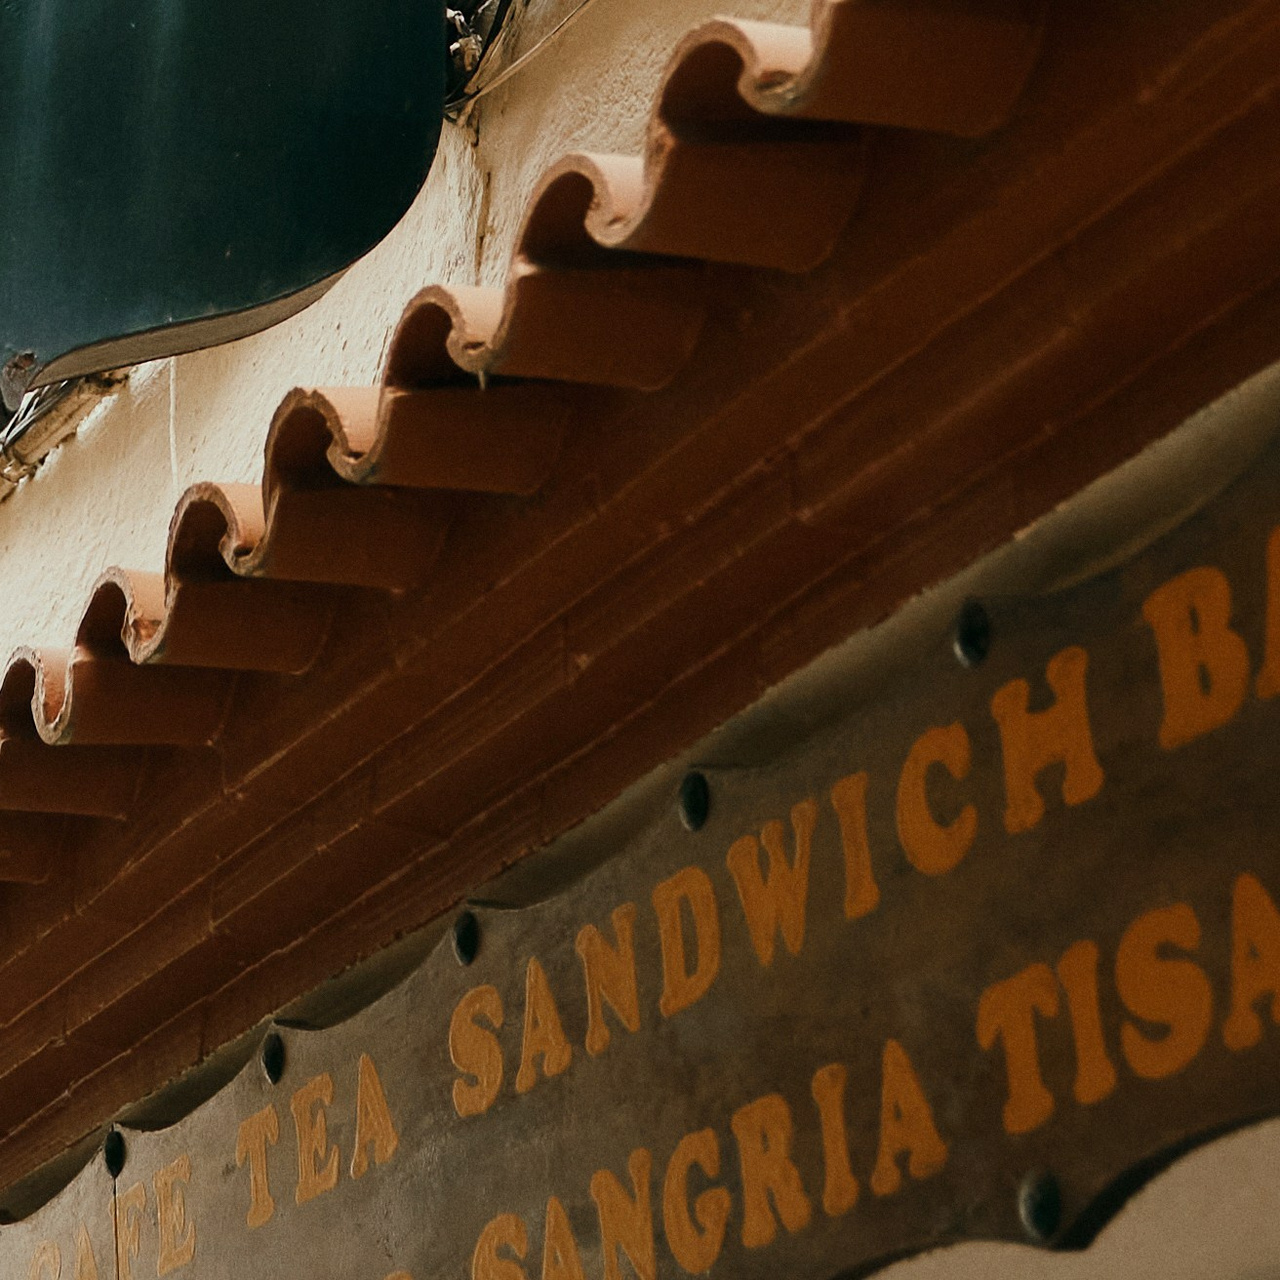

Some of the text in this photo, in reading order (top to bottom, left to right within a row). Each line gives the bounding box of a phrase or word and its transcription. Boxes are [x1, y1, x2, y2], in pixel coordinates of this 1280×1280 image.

[235, 1053, 399, 1228] TEA
[449, 645, 1105, 1117] SANDWICH
[1142, 525, 1280, 749] B
